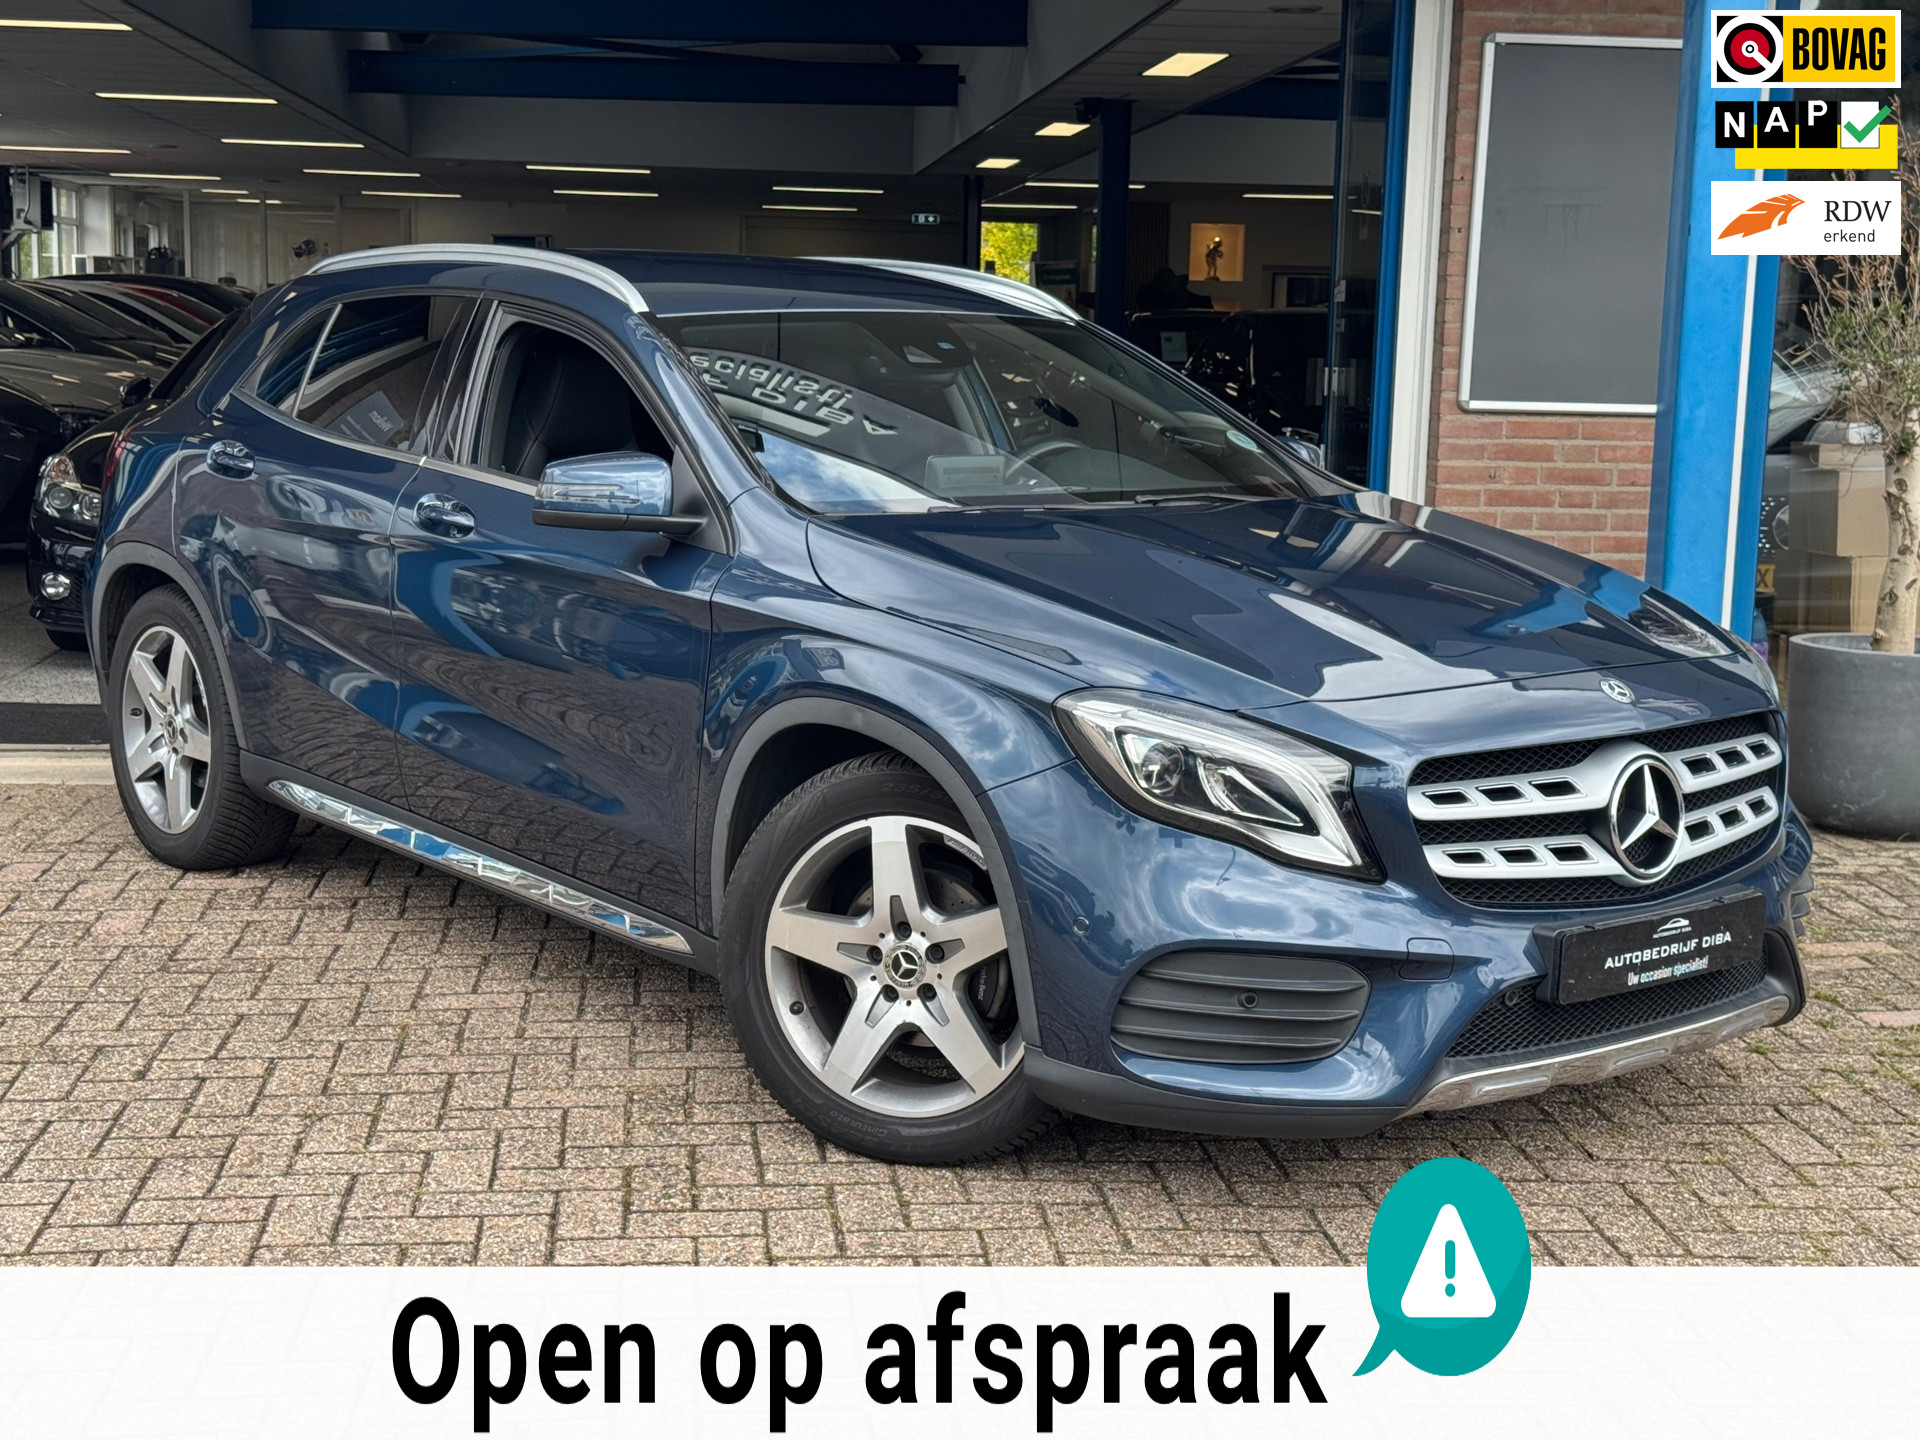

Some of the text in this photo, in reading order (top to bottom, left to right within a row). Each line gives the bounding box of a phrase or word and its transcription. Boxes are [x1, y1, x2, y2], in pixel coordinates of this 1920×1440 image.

[1604, 931, 1732, 969] AUTOBEDRIJF DIBA
[1627, 955, 1709, 986] Uw occasion specialist!
[829, 1109, 889, 1138] Cinturato
